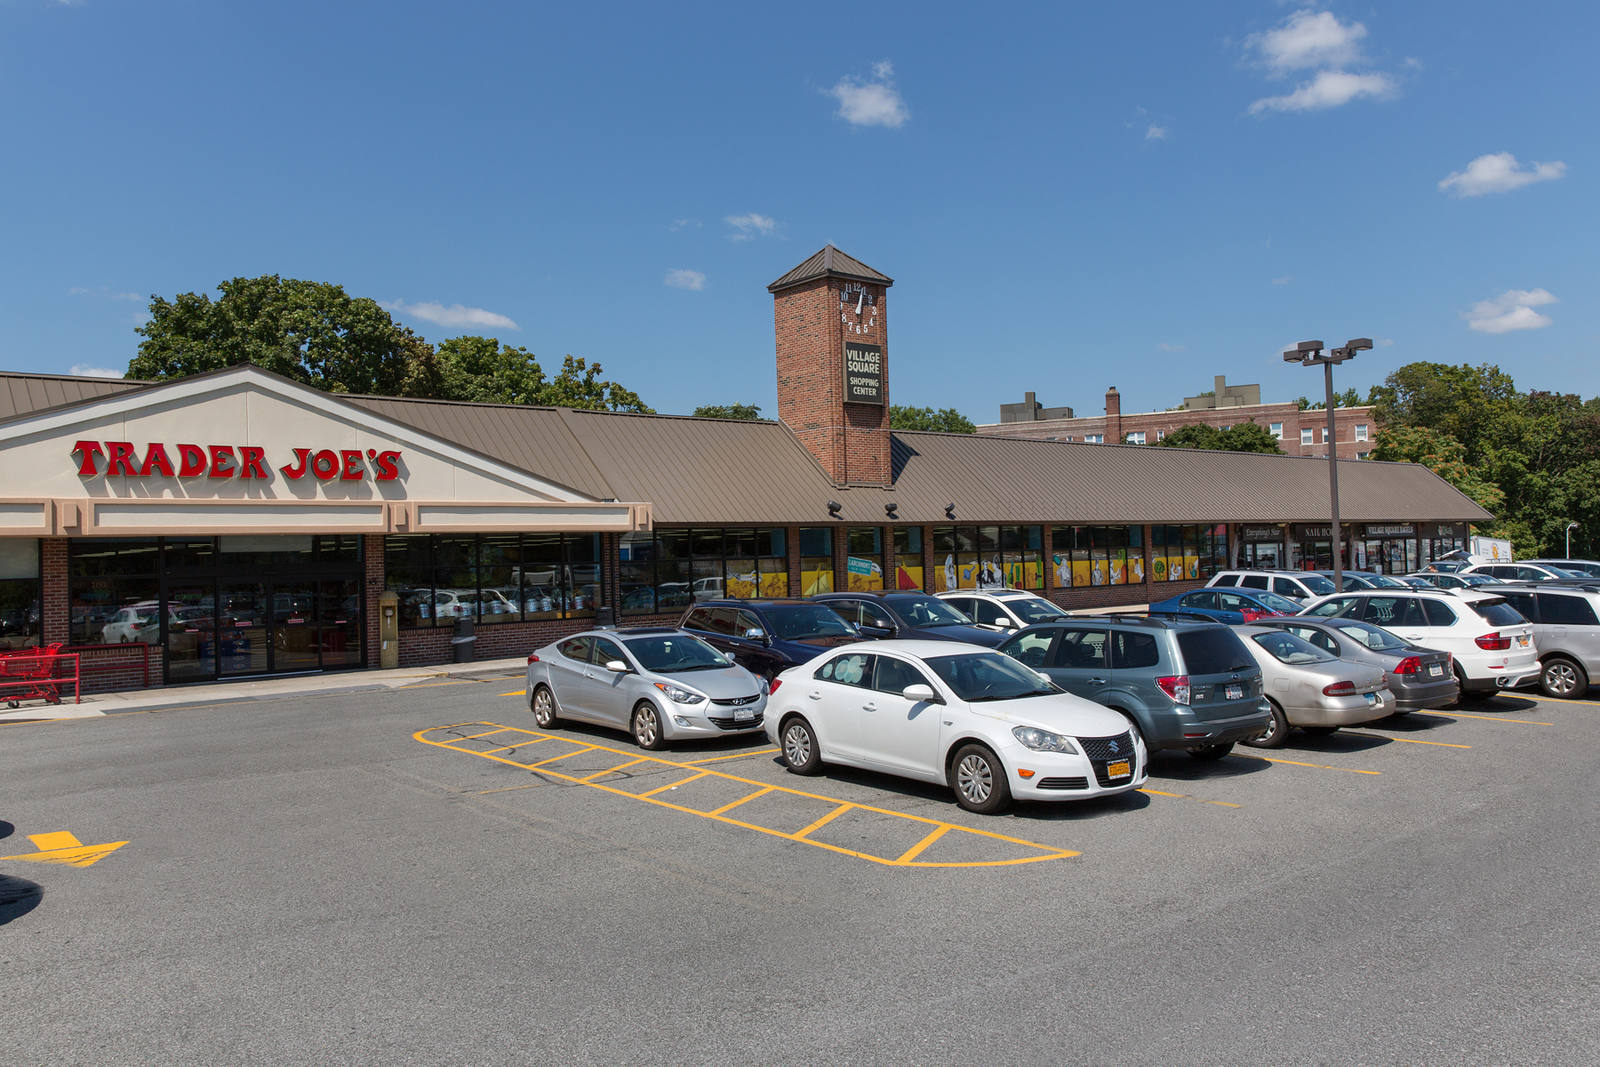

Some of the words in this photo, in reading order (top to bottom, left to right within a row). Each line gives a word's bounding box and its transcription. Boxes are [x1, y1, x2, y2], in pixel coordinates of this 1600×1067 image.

[845, 283, 852, 293] 11
[853, 282, 861, 292] 12
[841, 291, 849, 301] 10
[868, 295, 873, 305] 2
[872, 306, 877, 315] 3
[841, 313, 847, 323] 8
[869, 317, 874, 326] 4
[848, 322, 853, 331] 7
[856, 325, 861, 335] 6
[864, 324, 869, 334] 5
[846, 349, 880, 363] VILLAGE
[847, 360, 880, 374] SQUARE
[850, 376, 879, 387] SHOPPING
[853, 386, 877, 396] CENTER
[71, 440, 269, 480] TRADER
[279, 448, 402, 482] JOE'S
[1305, 527, 1320, 537] NAIL
